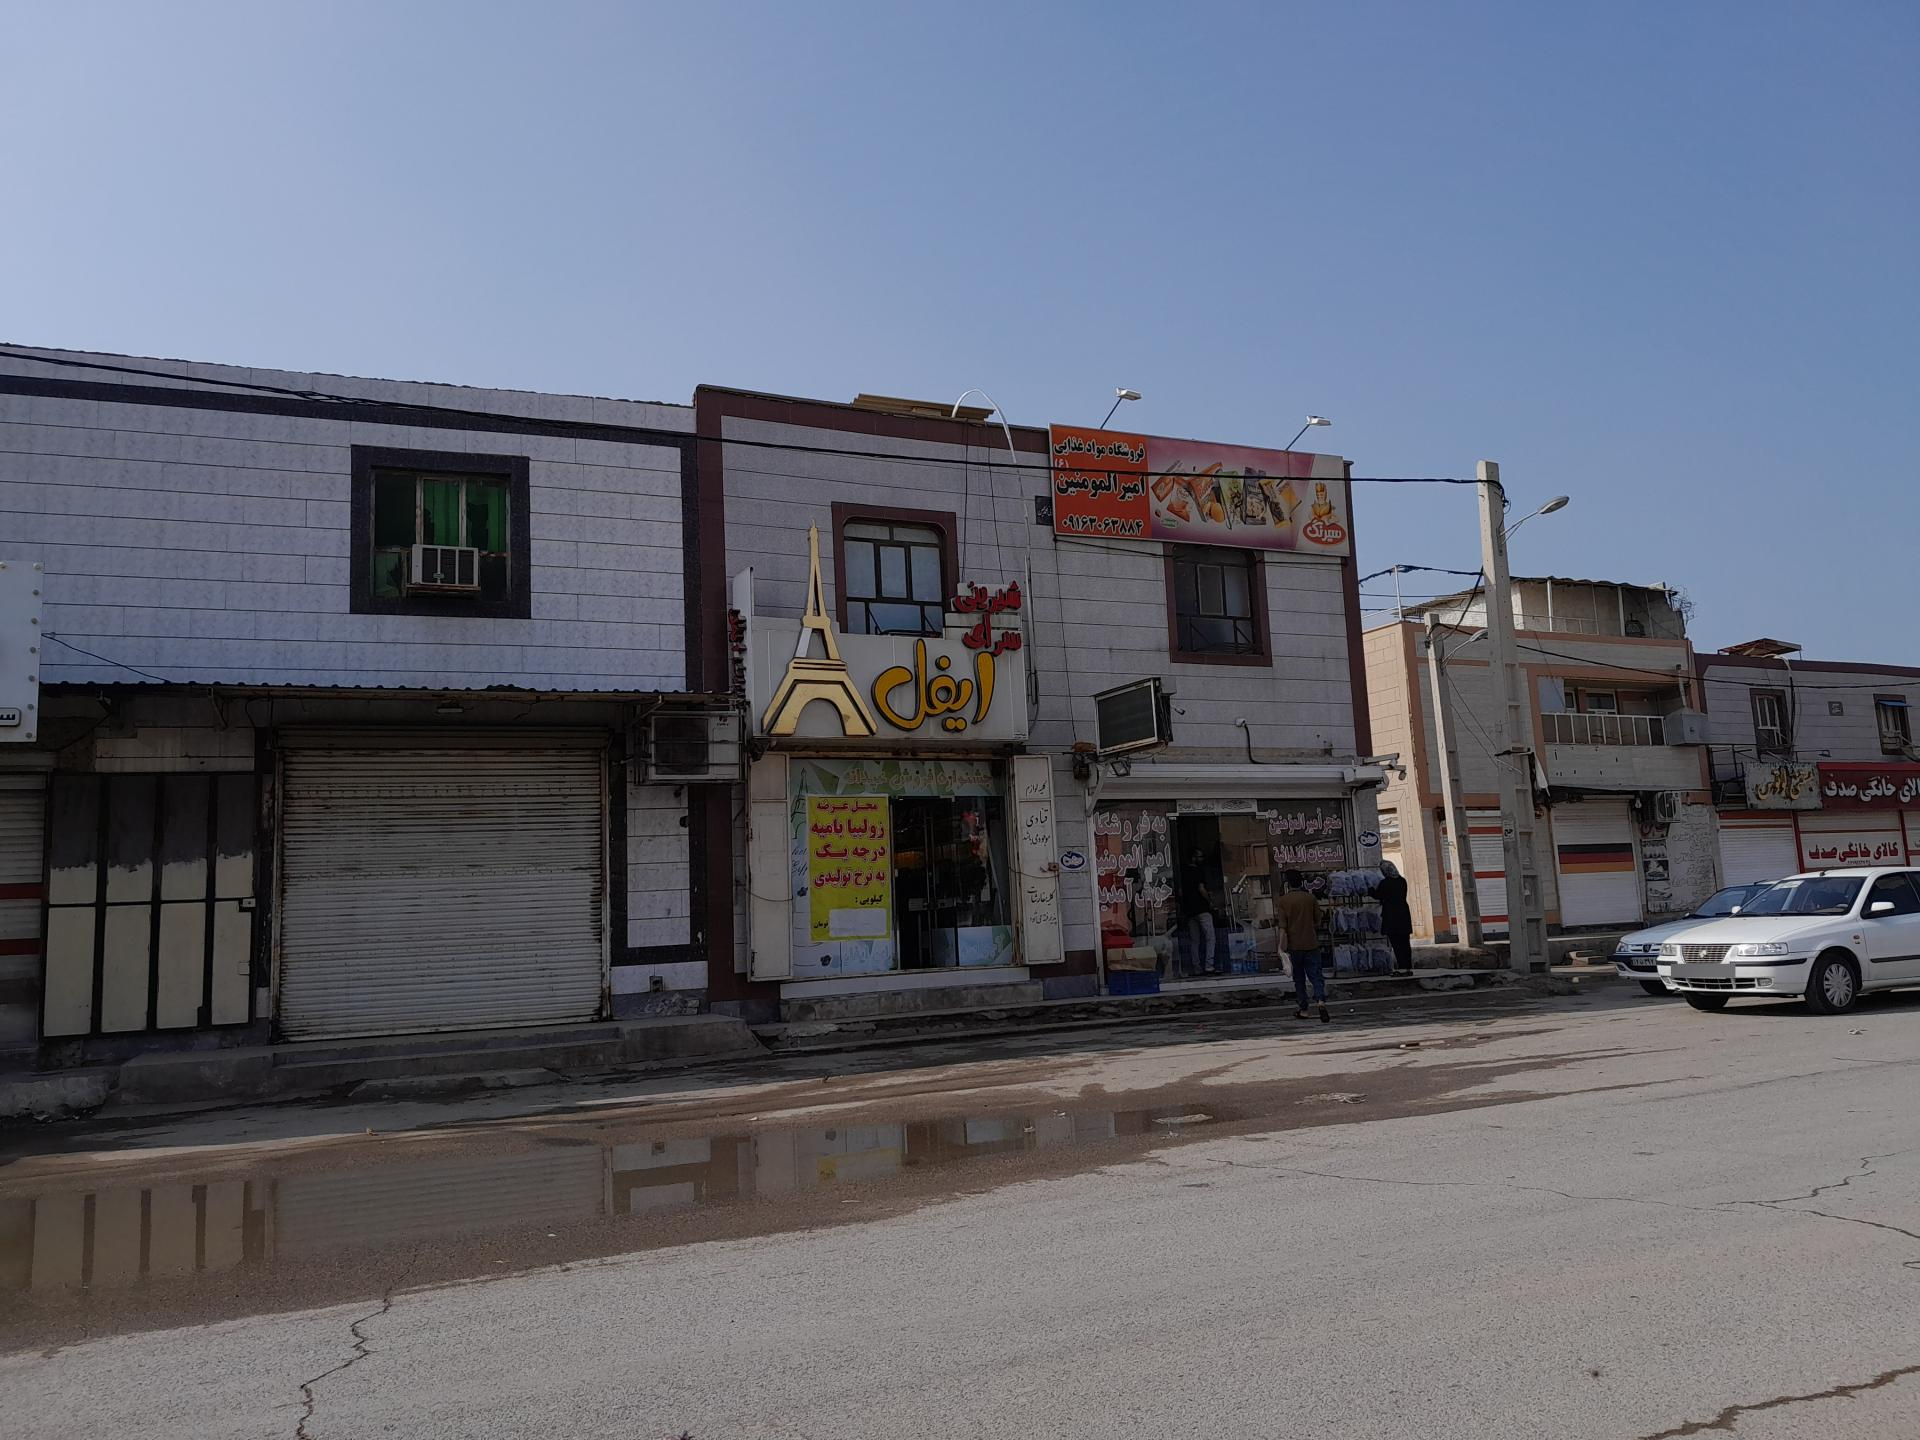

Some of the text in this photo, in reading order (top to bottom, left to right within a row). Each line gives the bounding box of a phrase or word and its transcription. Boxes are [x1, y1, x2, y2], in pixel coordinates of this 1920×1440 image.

[1054, 436, 1145, 463] فروشگاه مواد غذایی
[1056, 472, 1146, 501] امیر المومنین
[1062, 514, 1144, 535] ۰۹۱۶۳۰۶۳۸۸۴
[951, 580, 1022, 614] شیرینی
[962, 612, 1022, 656] سرای
[872, 639, 996, 731] ایفل
[1824, 772, 1920, 803] الای خانگی صدف
[816, 799, 877, 813] محل عرضه
[811, 819, 843, 838] بامیه
[1093, 810, 1167, 842] به فروشگا
[815, 843, 848, 861] یک
[852, 846, 885, 861] درجه
[1096, 844, 1143, 877] المومنی
[1146, 843, 1171, 874] امیر
[1809, 841, 1899, 862] کالای خانگی صدف
[814, 867, 851, 888] تولیدی
[854, 868, 872, 886] نرخ
[876, 871, 885, 885] به
